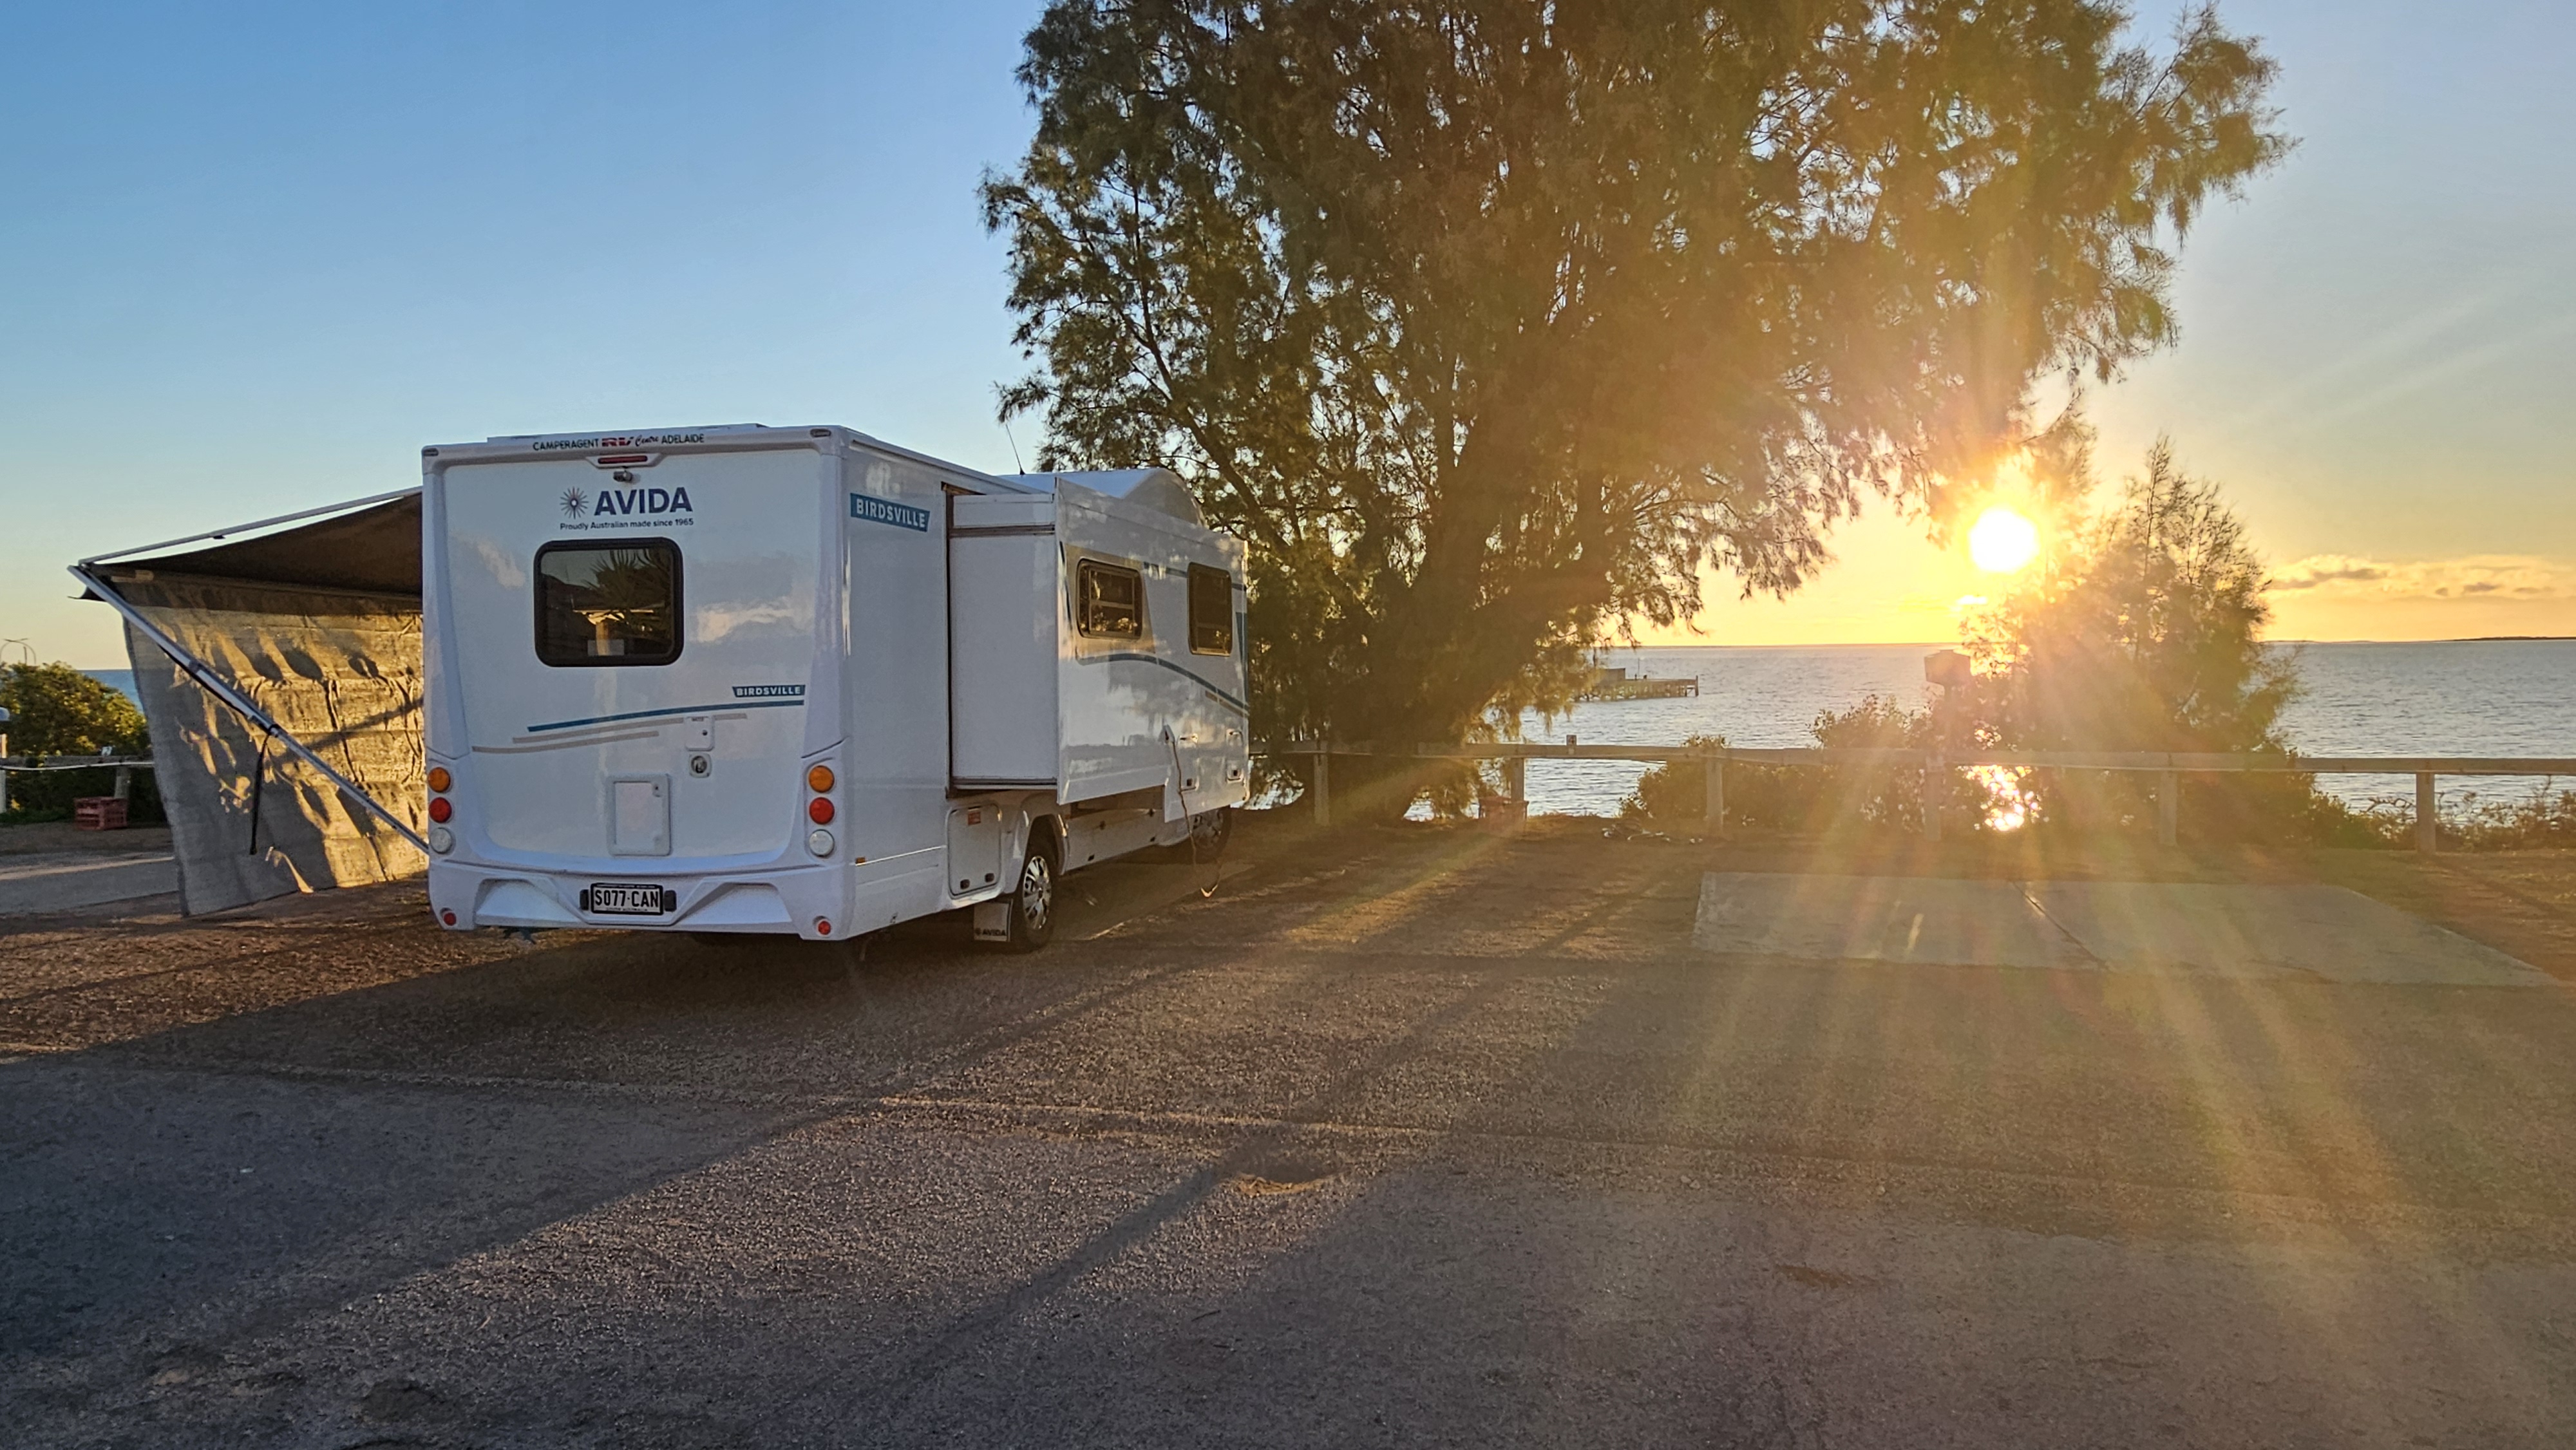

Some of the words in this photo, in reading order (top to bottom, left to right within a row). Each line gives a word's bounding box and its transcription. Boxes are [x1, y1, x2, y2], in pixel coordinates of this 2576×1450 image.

[533, 438, 600, 451] CAMPERAGENT
[661, 433, 705, 445] ADELAIDE
[594, 487, 694, 516] AVIDA
[856, 498, 925, 528] BIRDSVILLE
[560, 522, 589, 531] Proudly
[590, 521, 629, 529] Australian
[630, 519, 651, 527] made
[675, 518, 694, 526] 1965
[736, 686, 801, 696] BIRDSVILLE
